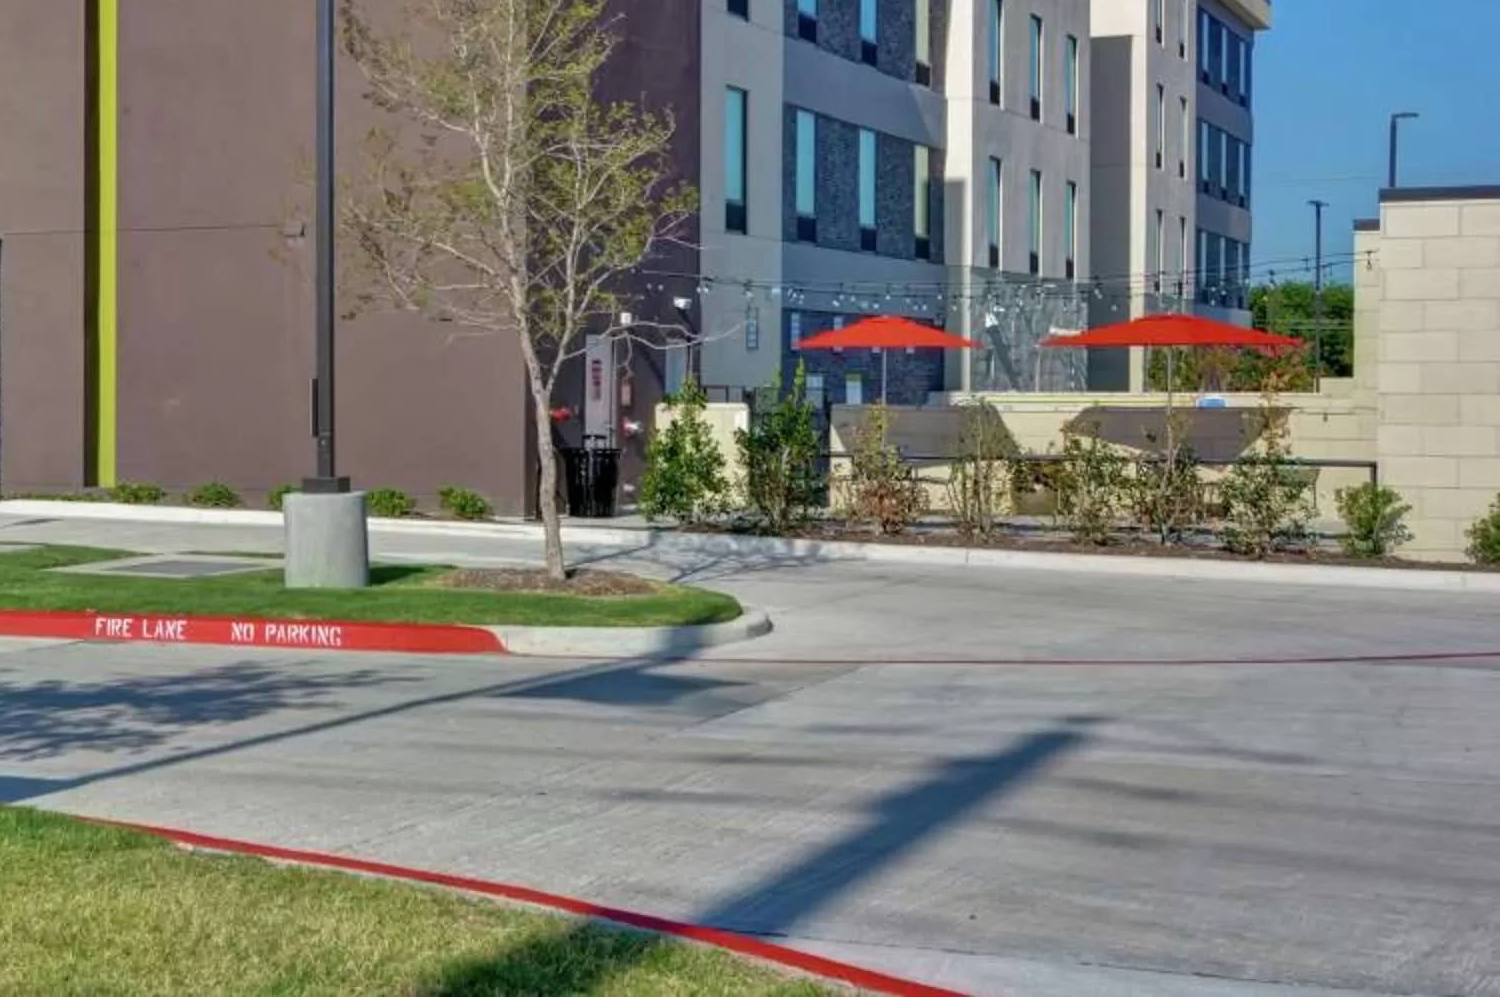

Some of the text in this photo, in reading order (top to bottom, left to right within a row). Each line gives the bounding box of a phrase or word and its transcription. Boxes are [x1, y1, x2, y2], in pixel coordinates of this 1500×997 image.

[94, 616, 342, 648] FIRE LANE NO PARKING
